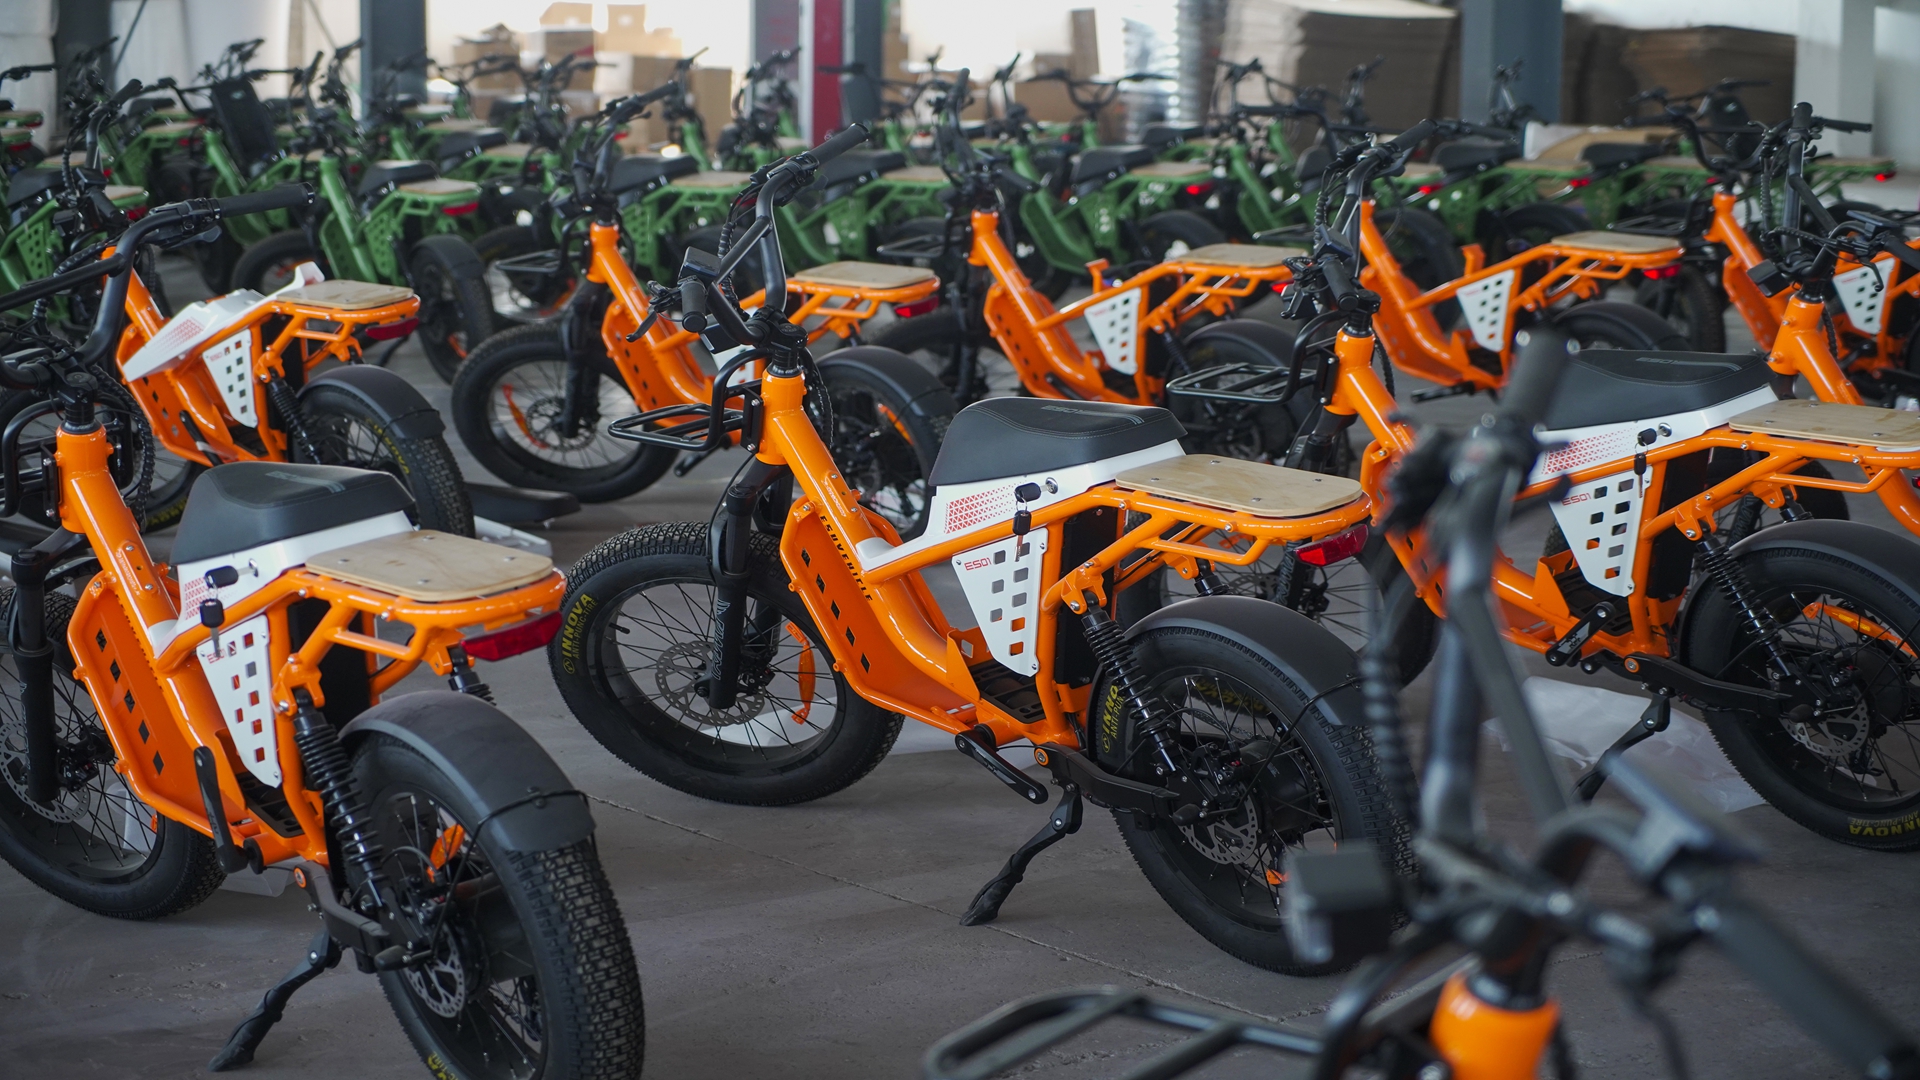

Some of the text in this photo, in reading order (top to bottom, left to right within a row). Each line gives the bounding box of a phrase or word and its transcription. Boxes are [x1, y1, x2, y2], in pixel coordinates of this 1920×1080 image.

[1562, 493, 1592, 506] ES01
[964, 557, 992, 571] ES01
[562, 593, 592, 658] INNOVA
[572, 599, 598, 659] ANTI-PUNC-TIRE
[1102, 685, 1119, 734] INNO
[1110, 696, 1125, 739] ANTI-PUN
